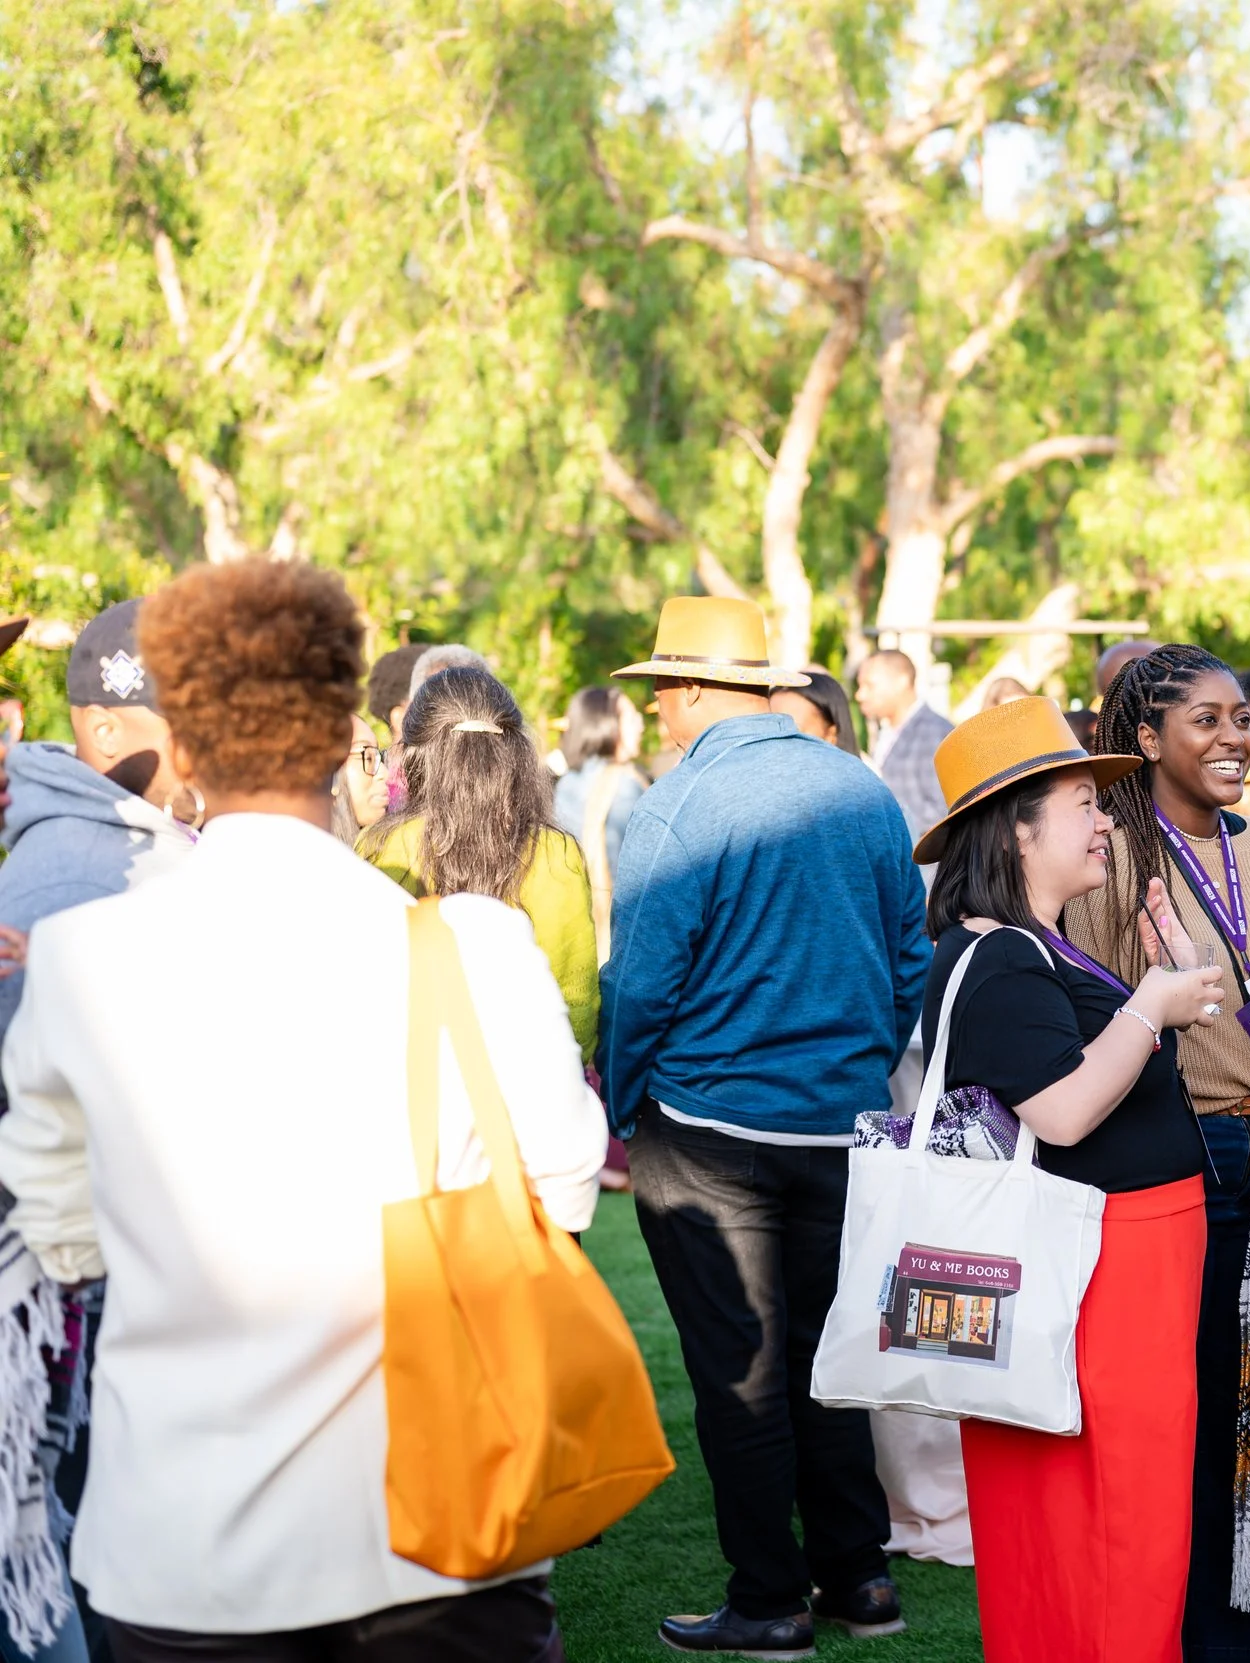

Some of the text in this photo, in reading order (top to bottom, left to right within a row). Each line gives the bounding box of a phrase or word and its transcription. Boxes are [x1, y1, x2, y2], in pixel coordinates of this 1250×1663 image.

[911, 1257, 1009, 1278] YU & ME BOOKS
